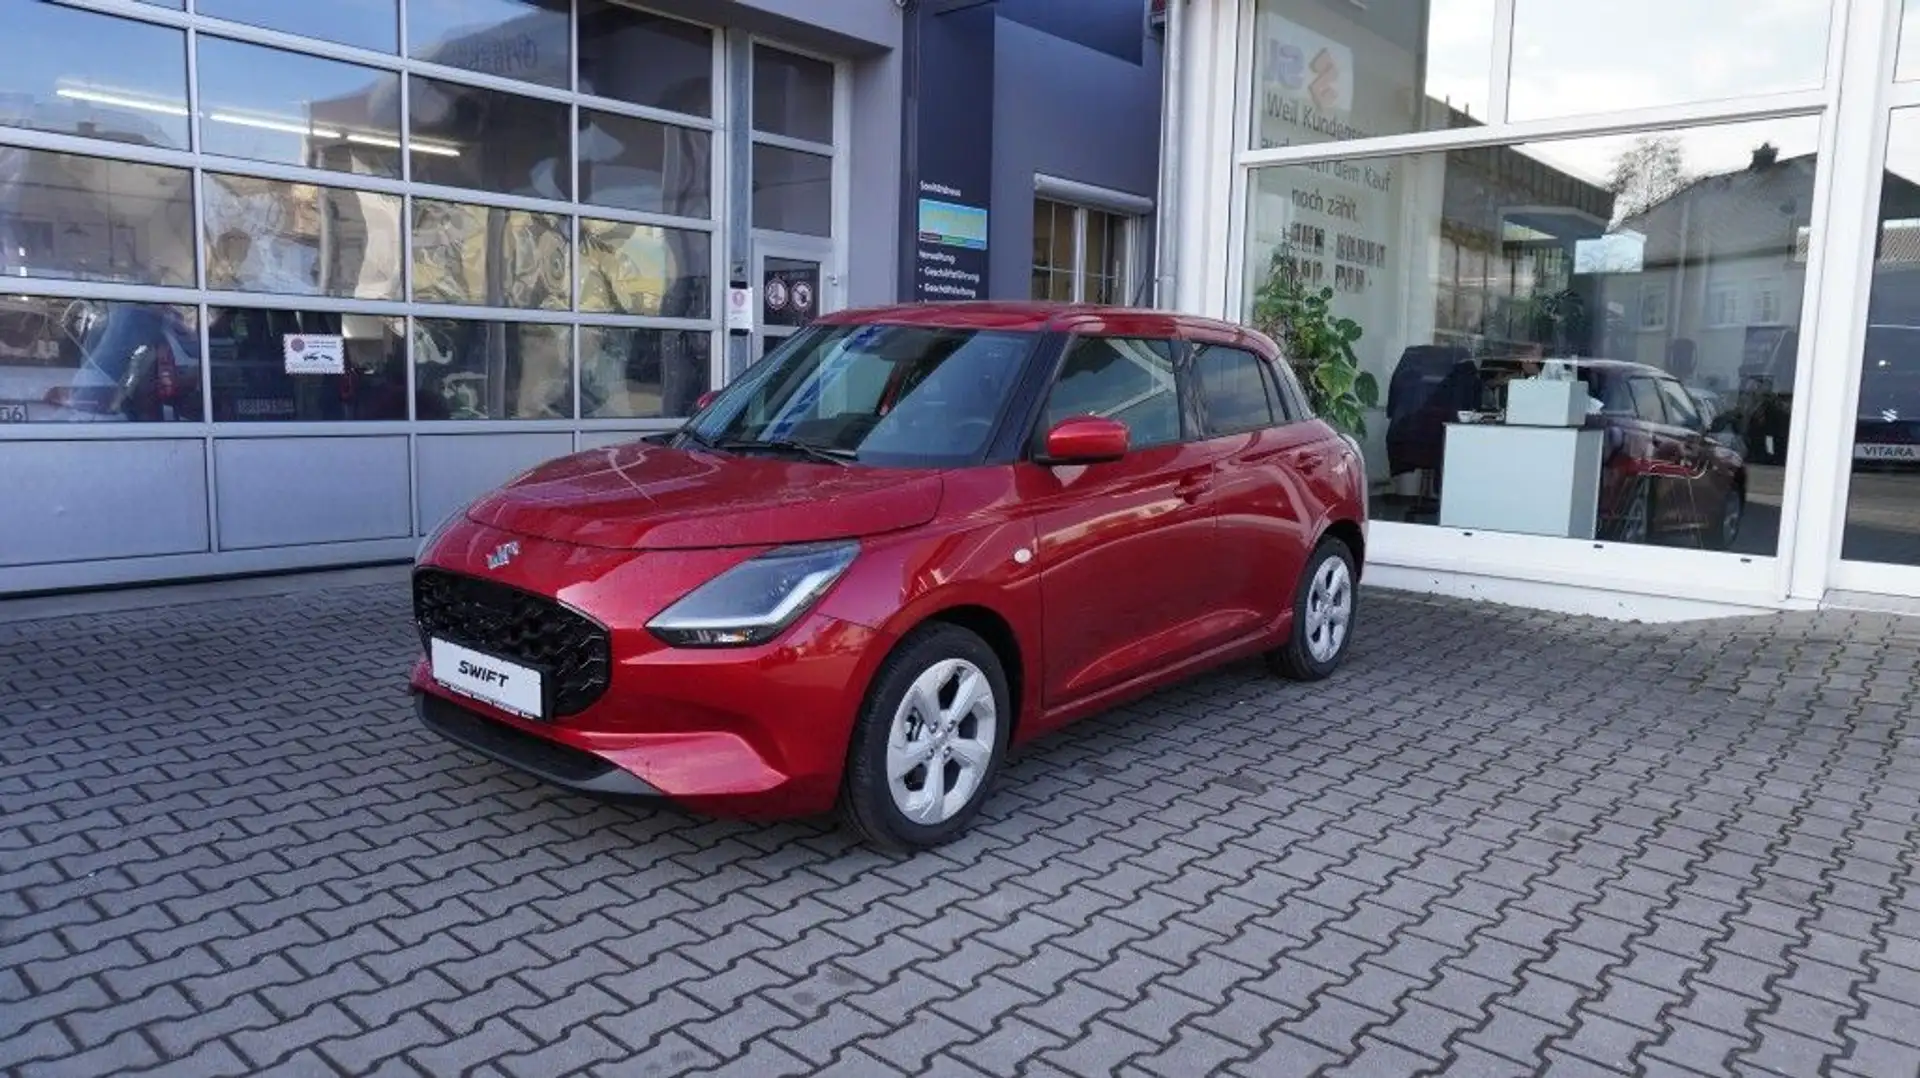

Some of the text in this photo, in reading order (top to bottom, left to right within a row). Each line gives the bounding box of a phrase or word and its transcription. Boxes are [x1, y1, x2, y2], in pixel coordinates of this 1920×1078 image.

[1291, 187, 1324, 213] noch
[1863, 446, 1915, 457] VITARA
[458, 660, 510, 688] SWIFT
